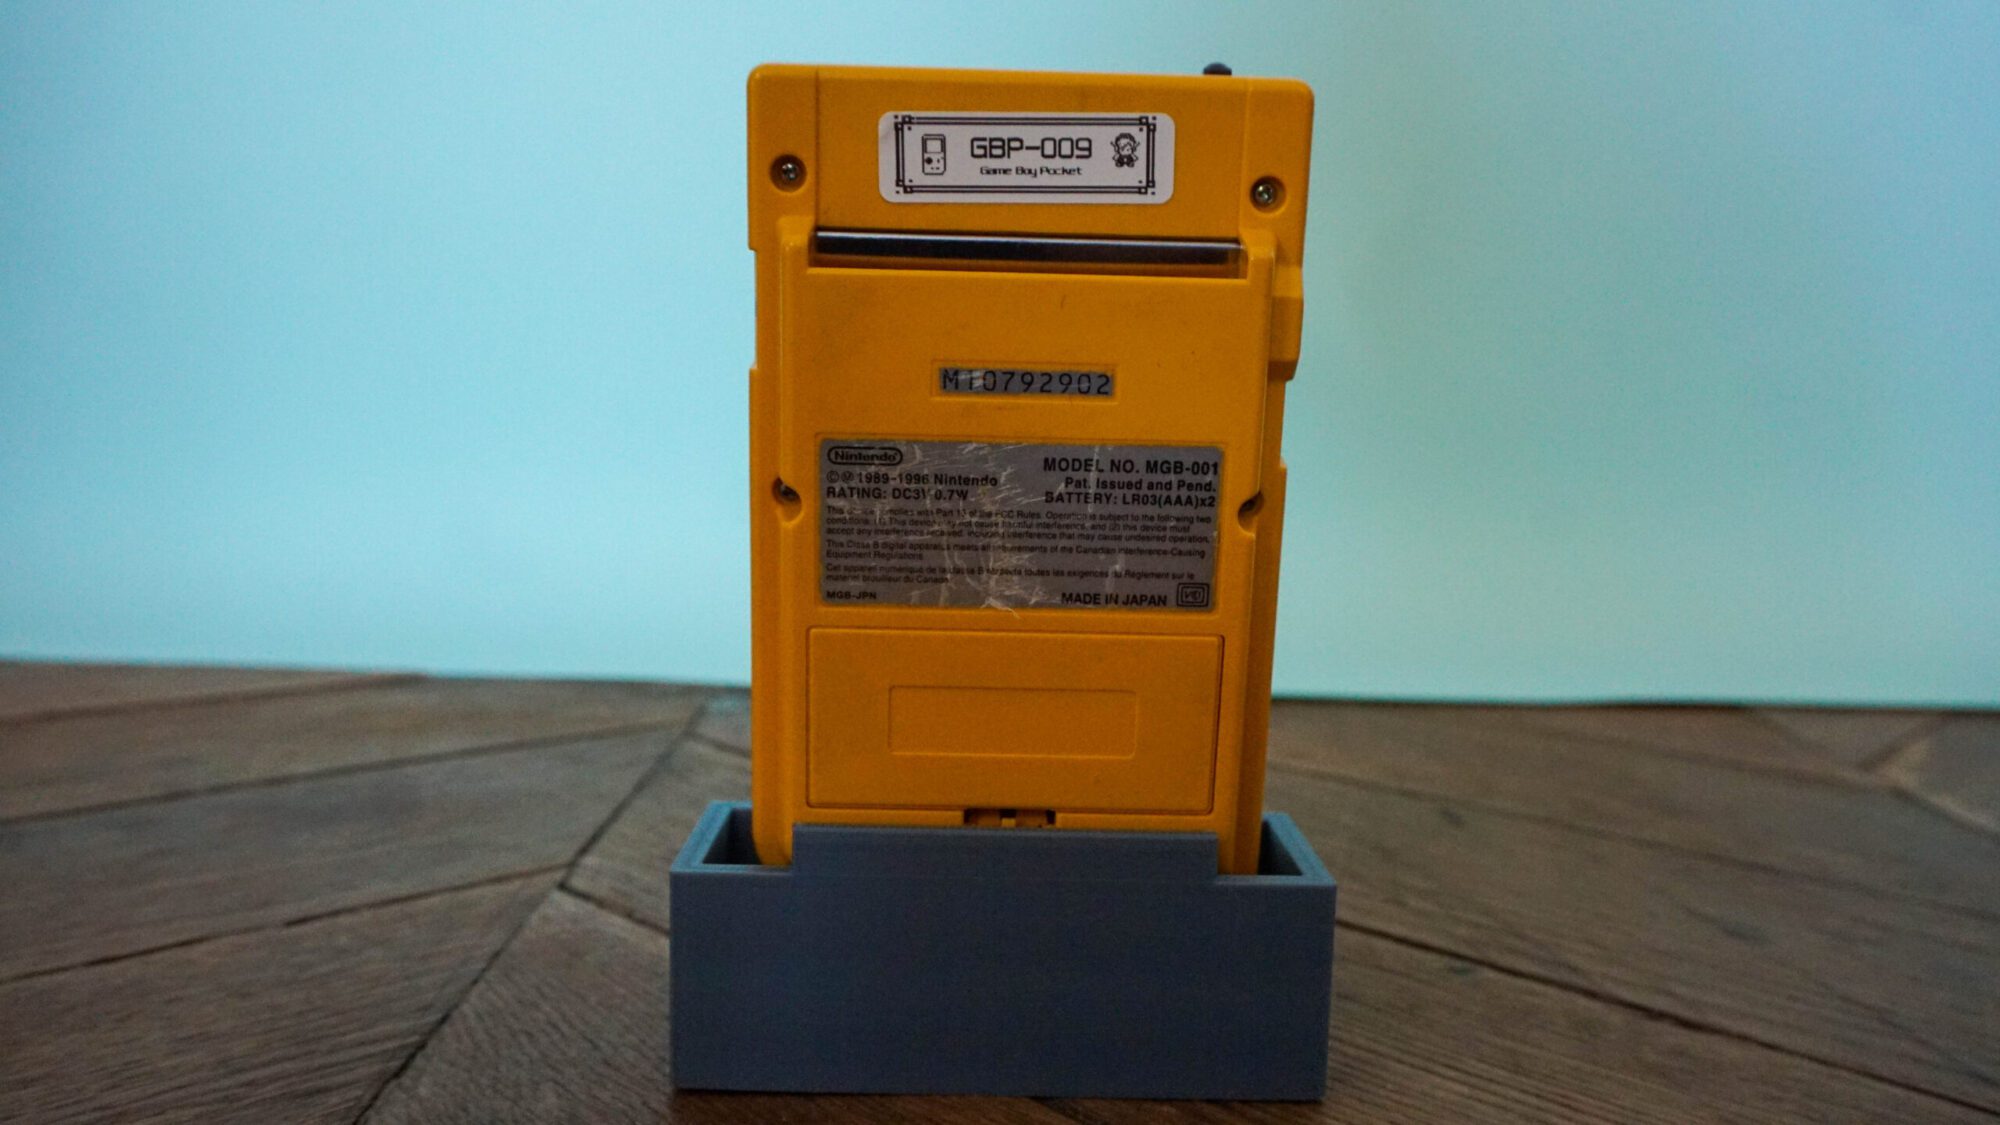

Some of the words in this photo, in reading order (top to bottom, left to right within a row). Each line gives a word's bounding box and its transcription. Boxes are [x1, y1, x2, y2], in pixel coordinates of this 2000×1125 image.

[970, 137, 1092, 159] GBP-009
[980, 166, 1012, 176] Game
[1016, 166, 1037, 178] Boy
[1040, 166, 1082, 176] Pocket
[834, 450, 897, 462] Nintendo
[1043, 457, 1104, 472] MODEL
[1110, 459, 1139, 473] NO.
[1146, 460, 1218, 475] MGB-001
[858, 472, 928, 485] 1989-1996
[934, 473, 998, 486] Nintendo
[1065, 477, 1091, 489] Pat.
[1097, 478, 1142, 490] Issued
[1147, 480, 1173, 490] and
[1178, 480, 1216, 492] Pend.
[827, 487, 886, 499] RATING:
[934, 489, 969, 500] 0.7W
[1045, 491, 1117, 504] BATTERY:
[1123, 493, 1216, 509] LR03(AAA)x2
[826, 591, 876, 599] MGB-JPN
[1061, 592, 1100, 604] MADE
[1105, 594, 1118, 604] IN
[1123, 594, 1167, 606] JAPAN
